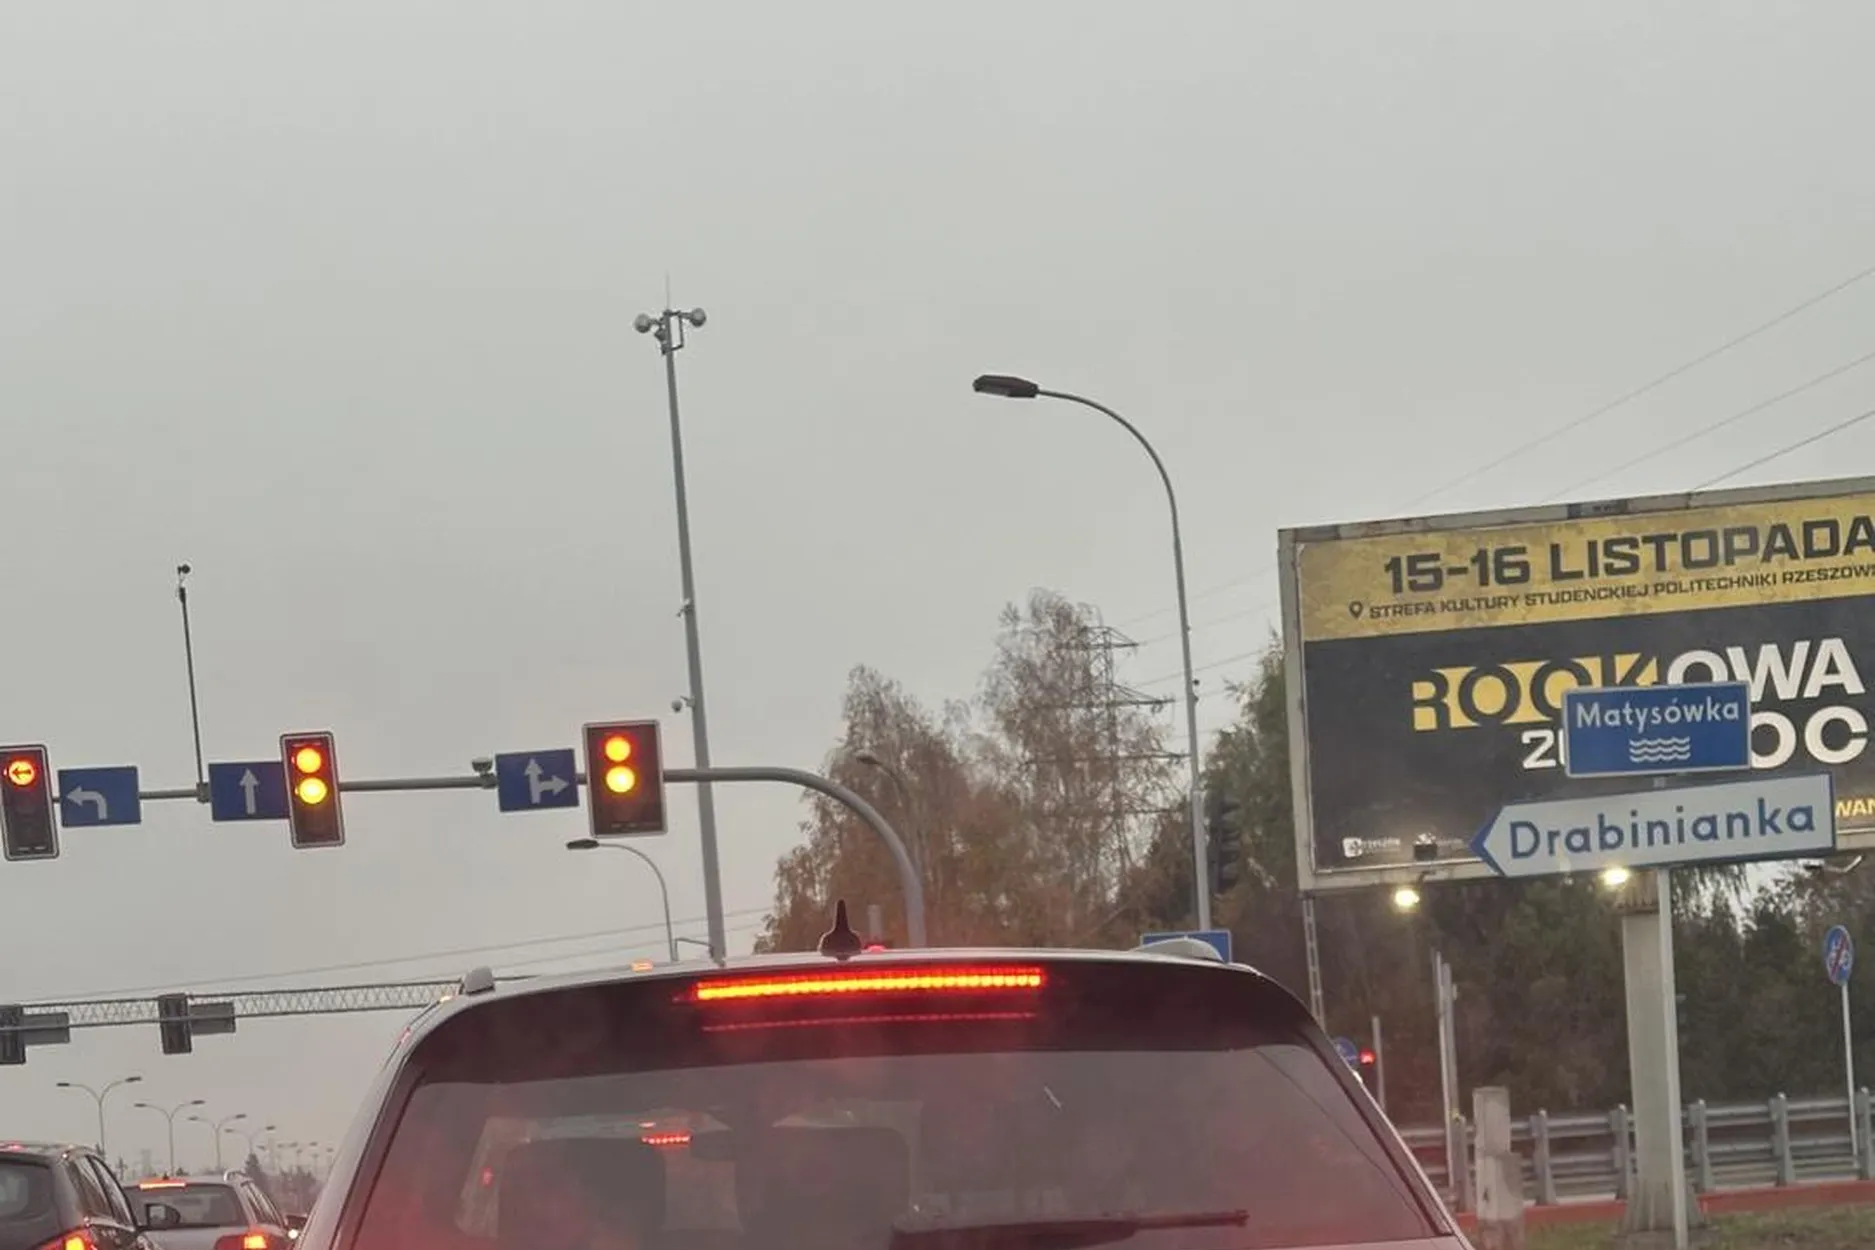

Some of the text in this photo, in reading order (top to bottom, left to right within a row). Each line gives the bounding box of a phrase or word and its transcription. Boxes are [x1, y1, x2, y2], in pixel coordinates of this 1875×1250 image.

[1384, 515, 1875, 594] 15-16 LISTOPADA
[1370, 564, 1875, 619] STREFA KULTURY STUDENCKIEJ POLITECHNIKI RZESZOW
[1576, 697, 1739, 733] Matysówka
[1751, 705, 1868, 768] OC
[1510, 797, 1815, 859] Drabinianka
